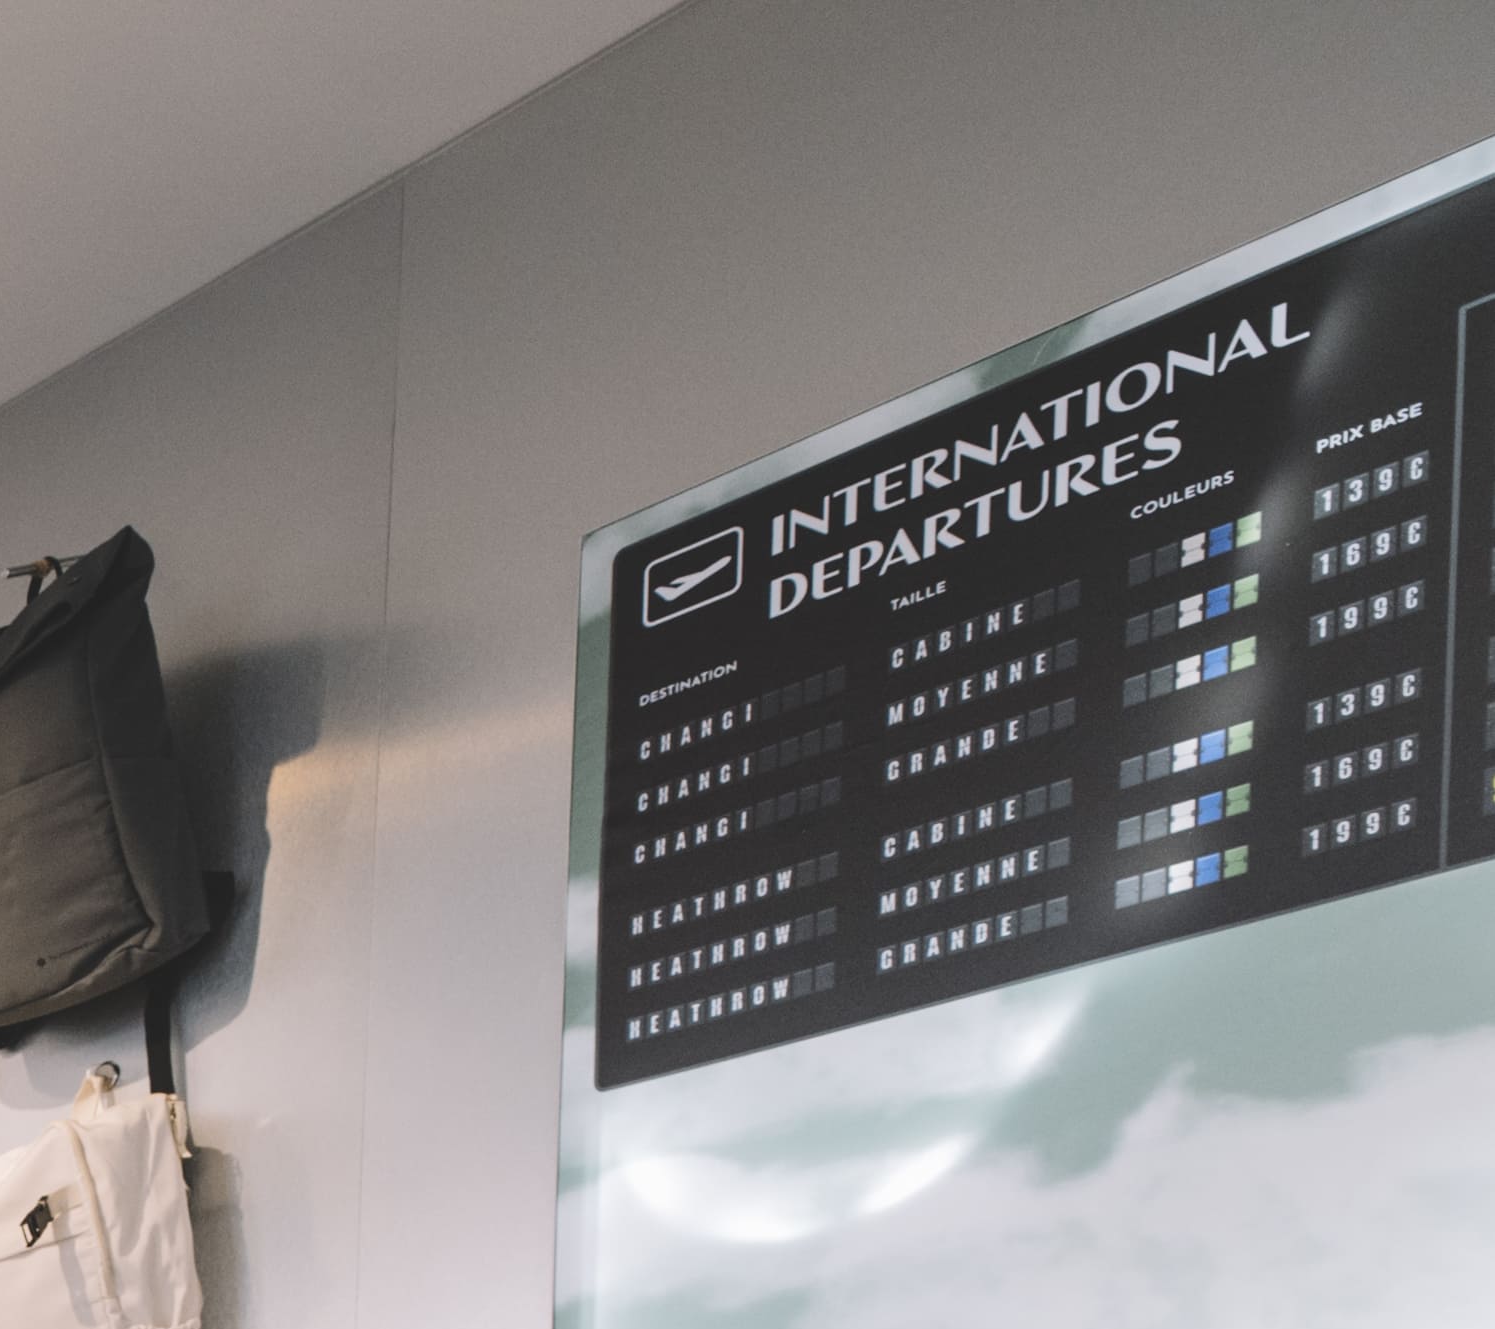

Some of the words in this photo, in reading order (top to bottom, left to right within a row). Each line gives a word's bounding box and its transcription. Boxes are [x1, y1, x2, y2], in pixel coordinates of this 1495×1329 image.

[771, 302, 1310, 557] INTERNATIONAL
[1316, 424, 1364, 454] PRIX
[1369, 402, 1423, 435] BASE
[1130, 470, 1235, 520] COULEURS
[1320, 454, 1424, 513] 139€
[768, 419, 1183, 620] DEPARTURES
[1318, 521, 1421, 577] 169€
[891, 580, 947, 612] TAILLE
[1316, 585, 1419, 640] 199€
[891, 602, 1024, 669] CABINE
[639, 660, 738, 707] DESTINATION
[887, 651, 1047, 726] MOYENNE
[1313, 674, 1416, 727] 139€
[640, 703, 752, 760] CHANGI
[887, 719, 1019, 782] GRANDE
[637, 757, 750, 812] CHANGI
[1311, 738, 1414, 790] 169€
[634, 810, 748, 864] CHANGI
[884, 799, 1017, 859] CABINE
[1309, 801, 1411, 852] 199€
[632, 869, 793, 936] HEATHROW
[880, 850, 1039, 915] MOYENNE
[630, 923, 790, 988] HEATHROW
[880, 915, 1013, 972] GRANDE
[629, 978, 789, 1042] HEATHROW
